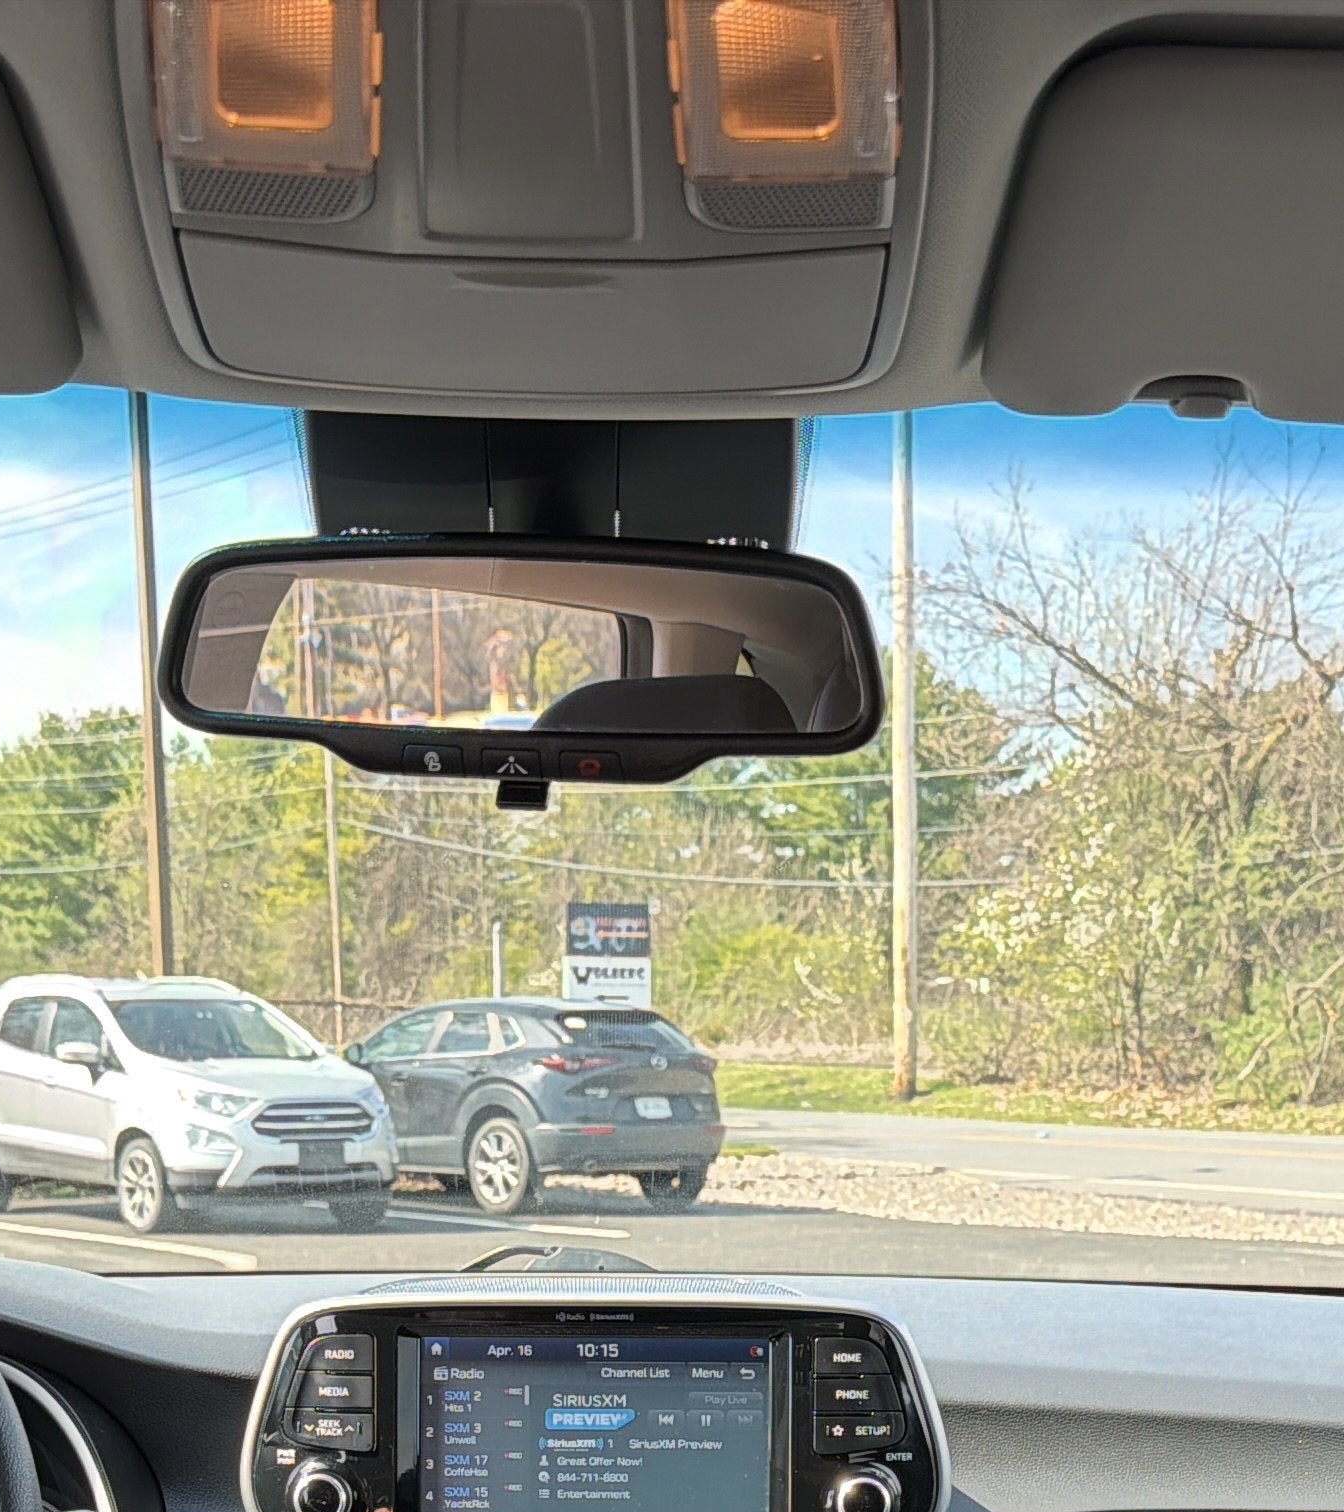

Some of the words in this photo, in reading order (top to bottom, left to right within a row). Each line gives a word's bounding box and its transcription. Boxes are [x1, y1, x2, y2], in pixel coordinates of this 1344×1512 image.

[324, 1350, 355, 1360] RADIO
[487, 1345, 514, 1357] Apr.
[517, 1345, 533, 1356] 16
[576, 1343, 619, 1358] 10:15
[832, 1352, 863, 1363] HOME
[450, 1368, 485, 1380] Radio
[600, 1367, 648, 1378] Channel
[649, 1367, 671, 1378] List
[692, 1367, 724, 1379] Menu
[318, 1386, 350, 1397] MEDIA
[444, 1391, 470, 1401] SXM
[473, 1391, 482, 1402] 2
[835, 1389, 870, 1400] PHONE
[426, 1394, 433, 1405] 1
[552, 1394, 627, 1407] SIRIUSXM
[704, 1396, 726, 1407] Play
[728, 1396, 747, 1405] Live
[444, 1403, 464, 1412] Hits
[467, 1403, 472, 1412] 1
[318, 1419, 340, 1427] SEEK
[552, 1413, 627, 1426] PREVIEW
[315, 1427, 343, 1436] TRACK
[425, 1427, 434, 1438] 2
[444, 1423, 470, 1433] SXM
[473, 1423, 482, 1433] 3
[855, 1425, 887, 1436] SETUP
[444, 1435, 477, 1445] Unwell
[628, 1439, 675, 1449] SiriusXM
[677, 1439, 723, 1449] Preview
[444, 1455, 470, 1465] SXM
[474, 1455, 489, 1465] 17
[556, 1457, 587, 1466] Great
[588, 1457, 615, 1466] Offer
[617, 1457, 644, 1466] Now!
[885, 1452, 913, 1462] ENTER
[425, 1458, 434, 1470] 3
[425, 1491, 434, 1502] 4
[444, 1487, 470, 1497] SXM
[474, 1487, 489, 1497] 15
[556, 1489, 631, 1499] Entertainment
